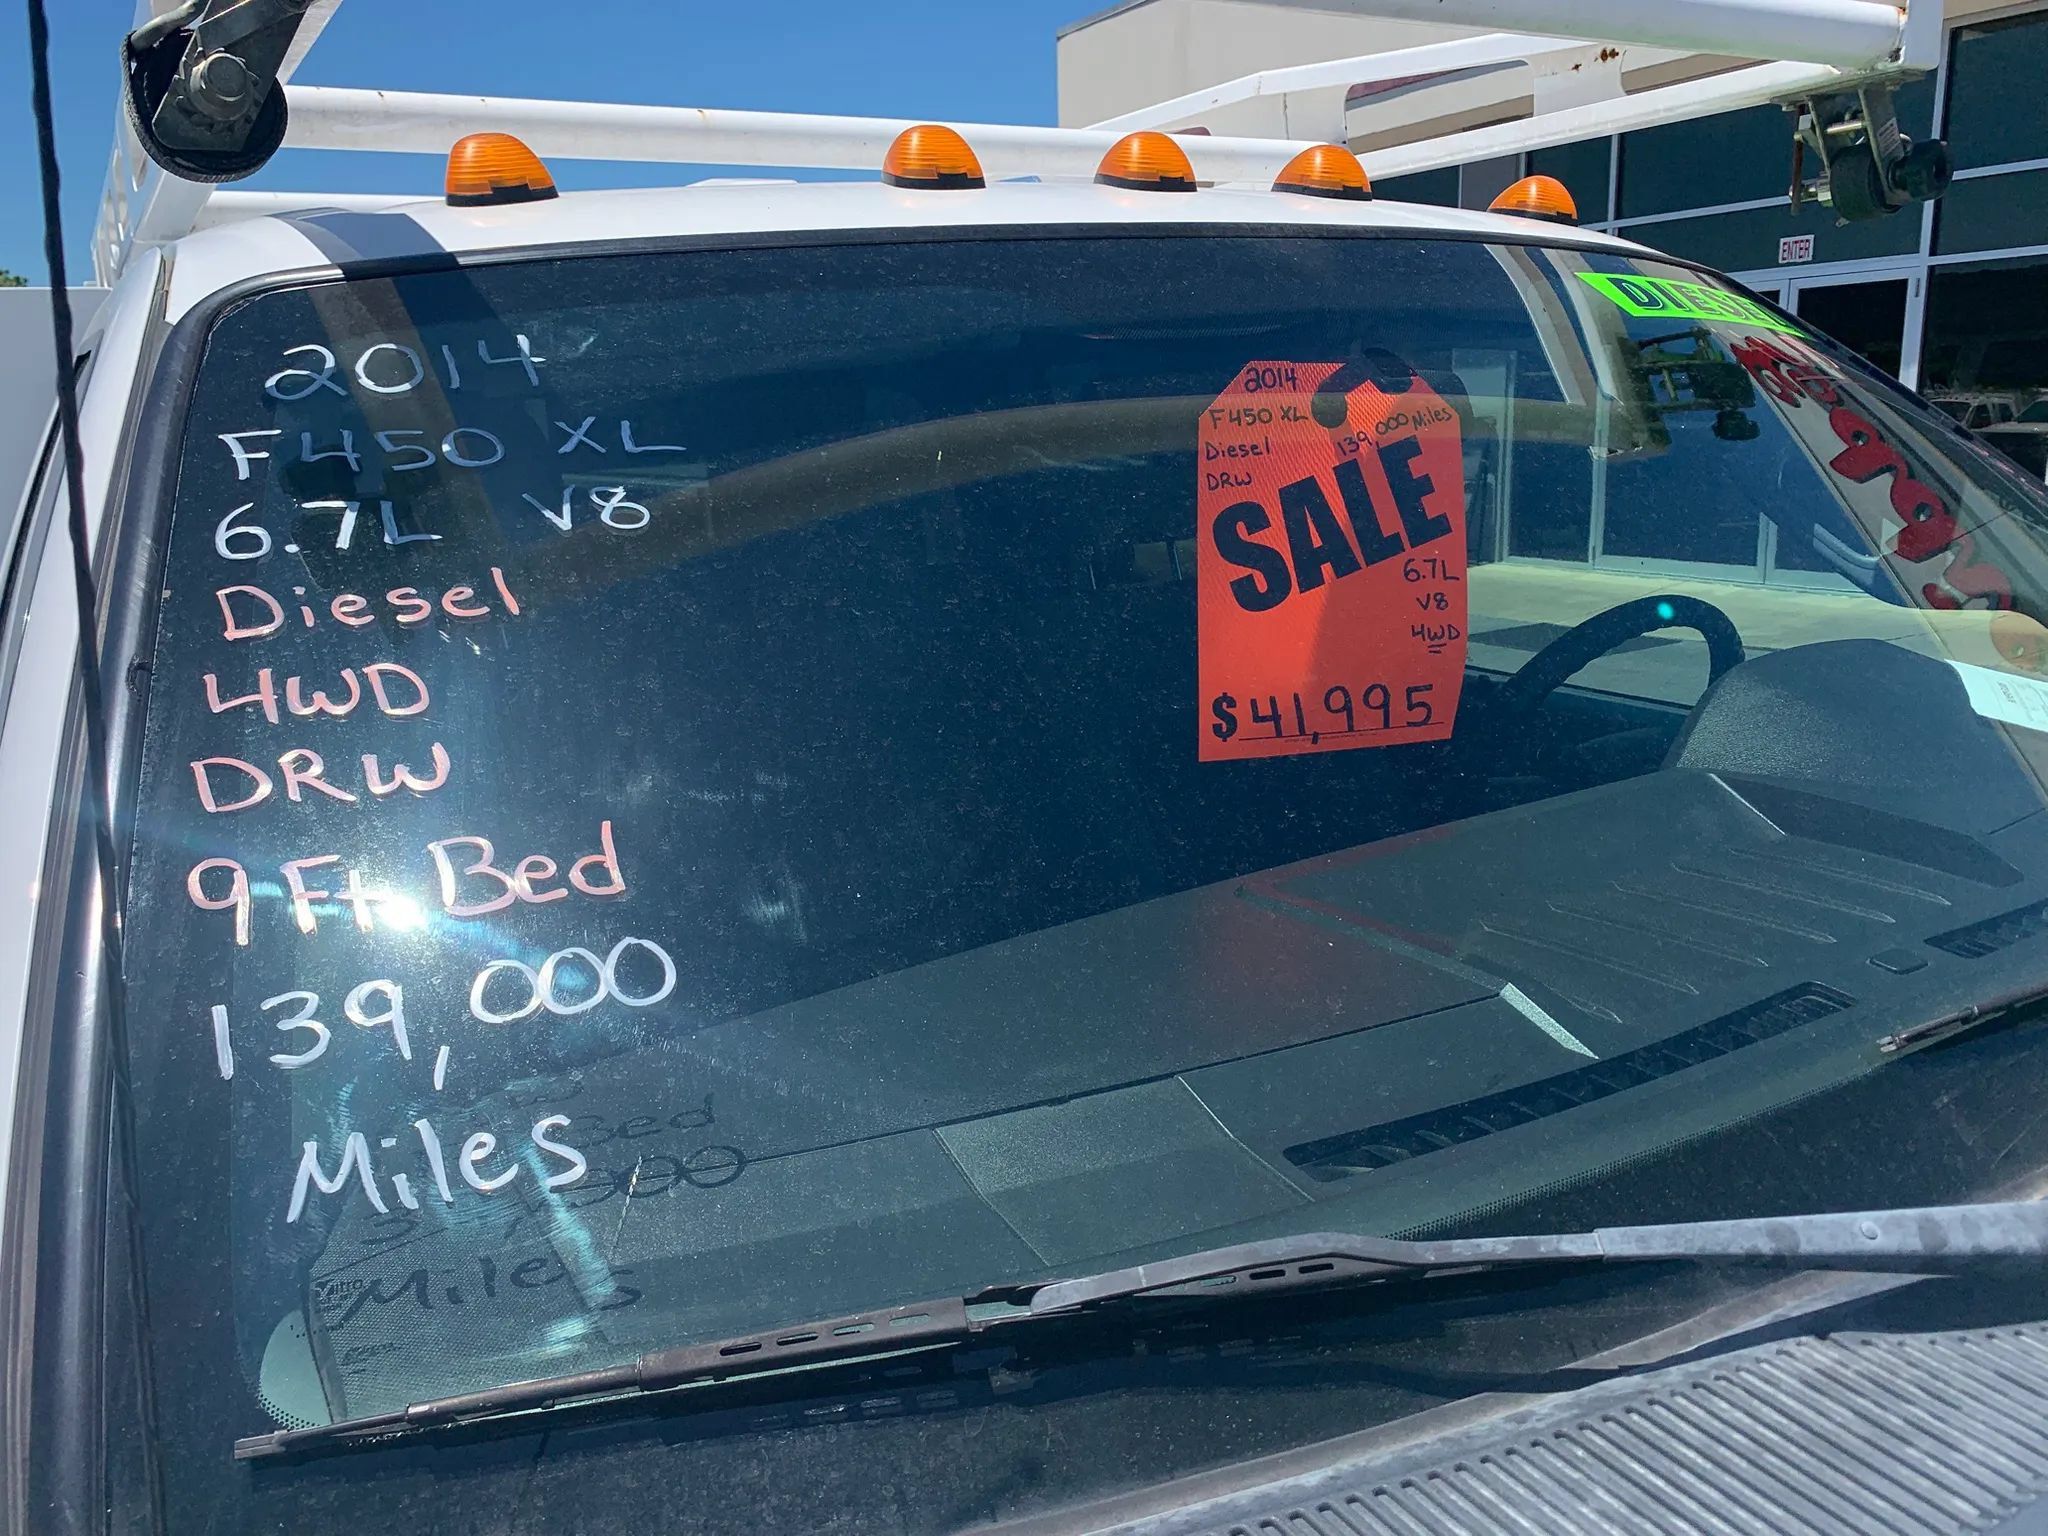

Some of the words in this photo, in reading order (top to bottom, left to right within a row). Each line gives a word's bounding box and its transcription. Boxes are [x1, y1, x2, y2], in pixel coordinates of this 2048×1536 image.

[1781, 239, 1811, 261] ENTER
[1607, 275, 1788, 326] DIESEL
[264, 334, 546, 399] 2014
[1244, 366, 1298, 393] 2014
[555, 416, 688, 454] XL
[1209, 406, 1273, 430] F450
[1280, 405, 1309, 422] XL
[1412, 405, 1453, 432] Miles
[1205, 436, 1271, 461] Diesel
[1206, 472, 1252, 491] DRW
[215, 500, 443, 560] 6.7L
[521, 485, 651, 531] V8
[1212, 434, 1453, 612] SALE
[1403, 558, 1460, 583] 6.7L
[216, 567, 520, 641] Diesel
[1416, 592, 1449, 611] V8
[1411, 624, 1461, 642] 4WD
[203, 662, 430, 725] 4WD
[1212, 684, 1434, 745] $41,995
[190, 742, 451, 813] DRW
[187, 857, 250, 946] 9
[281, 855, 388, 935] Ft
[428, 820, 627, 916] Bed
[210, 936, 677, 1090] 139,000
[287, 1113, 588, 1223] Miles
